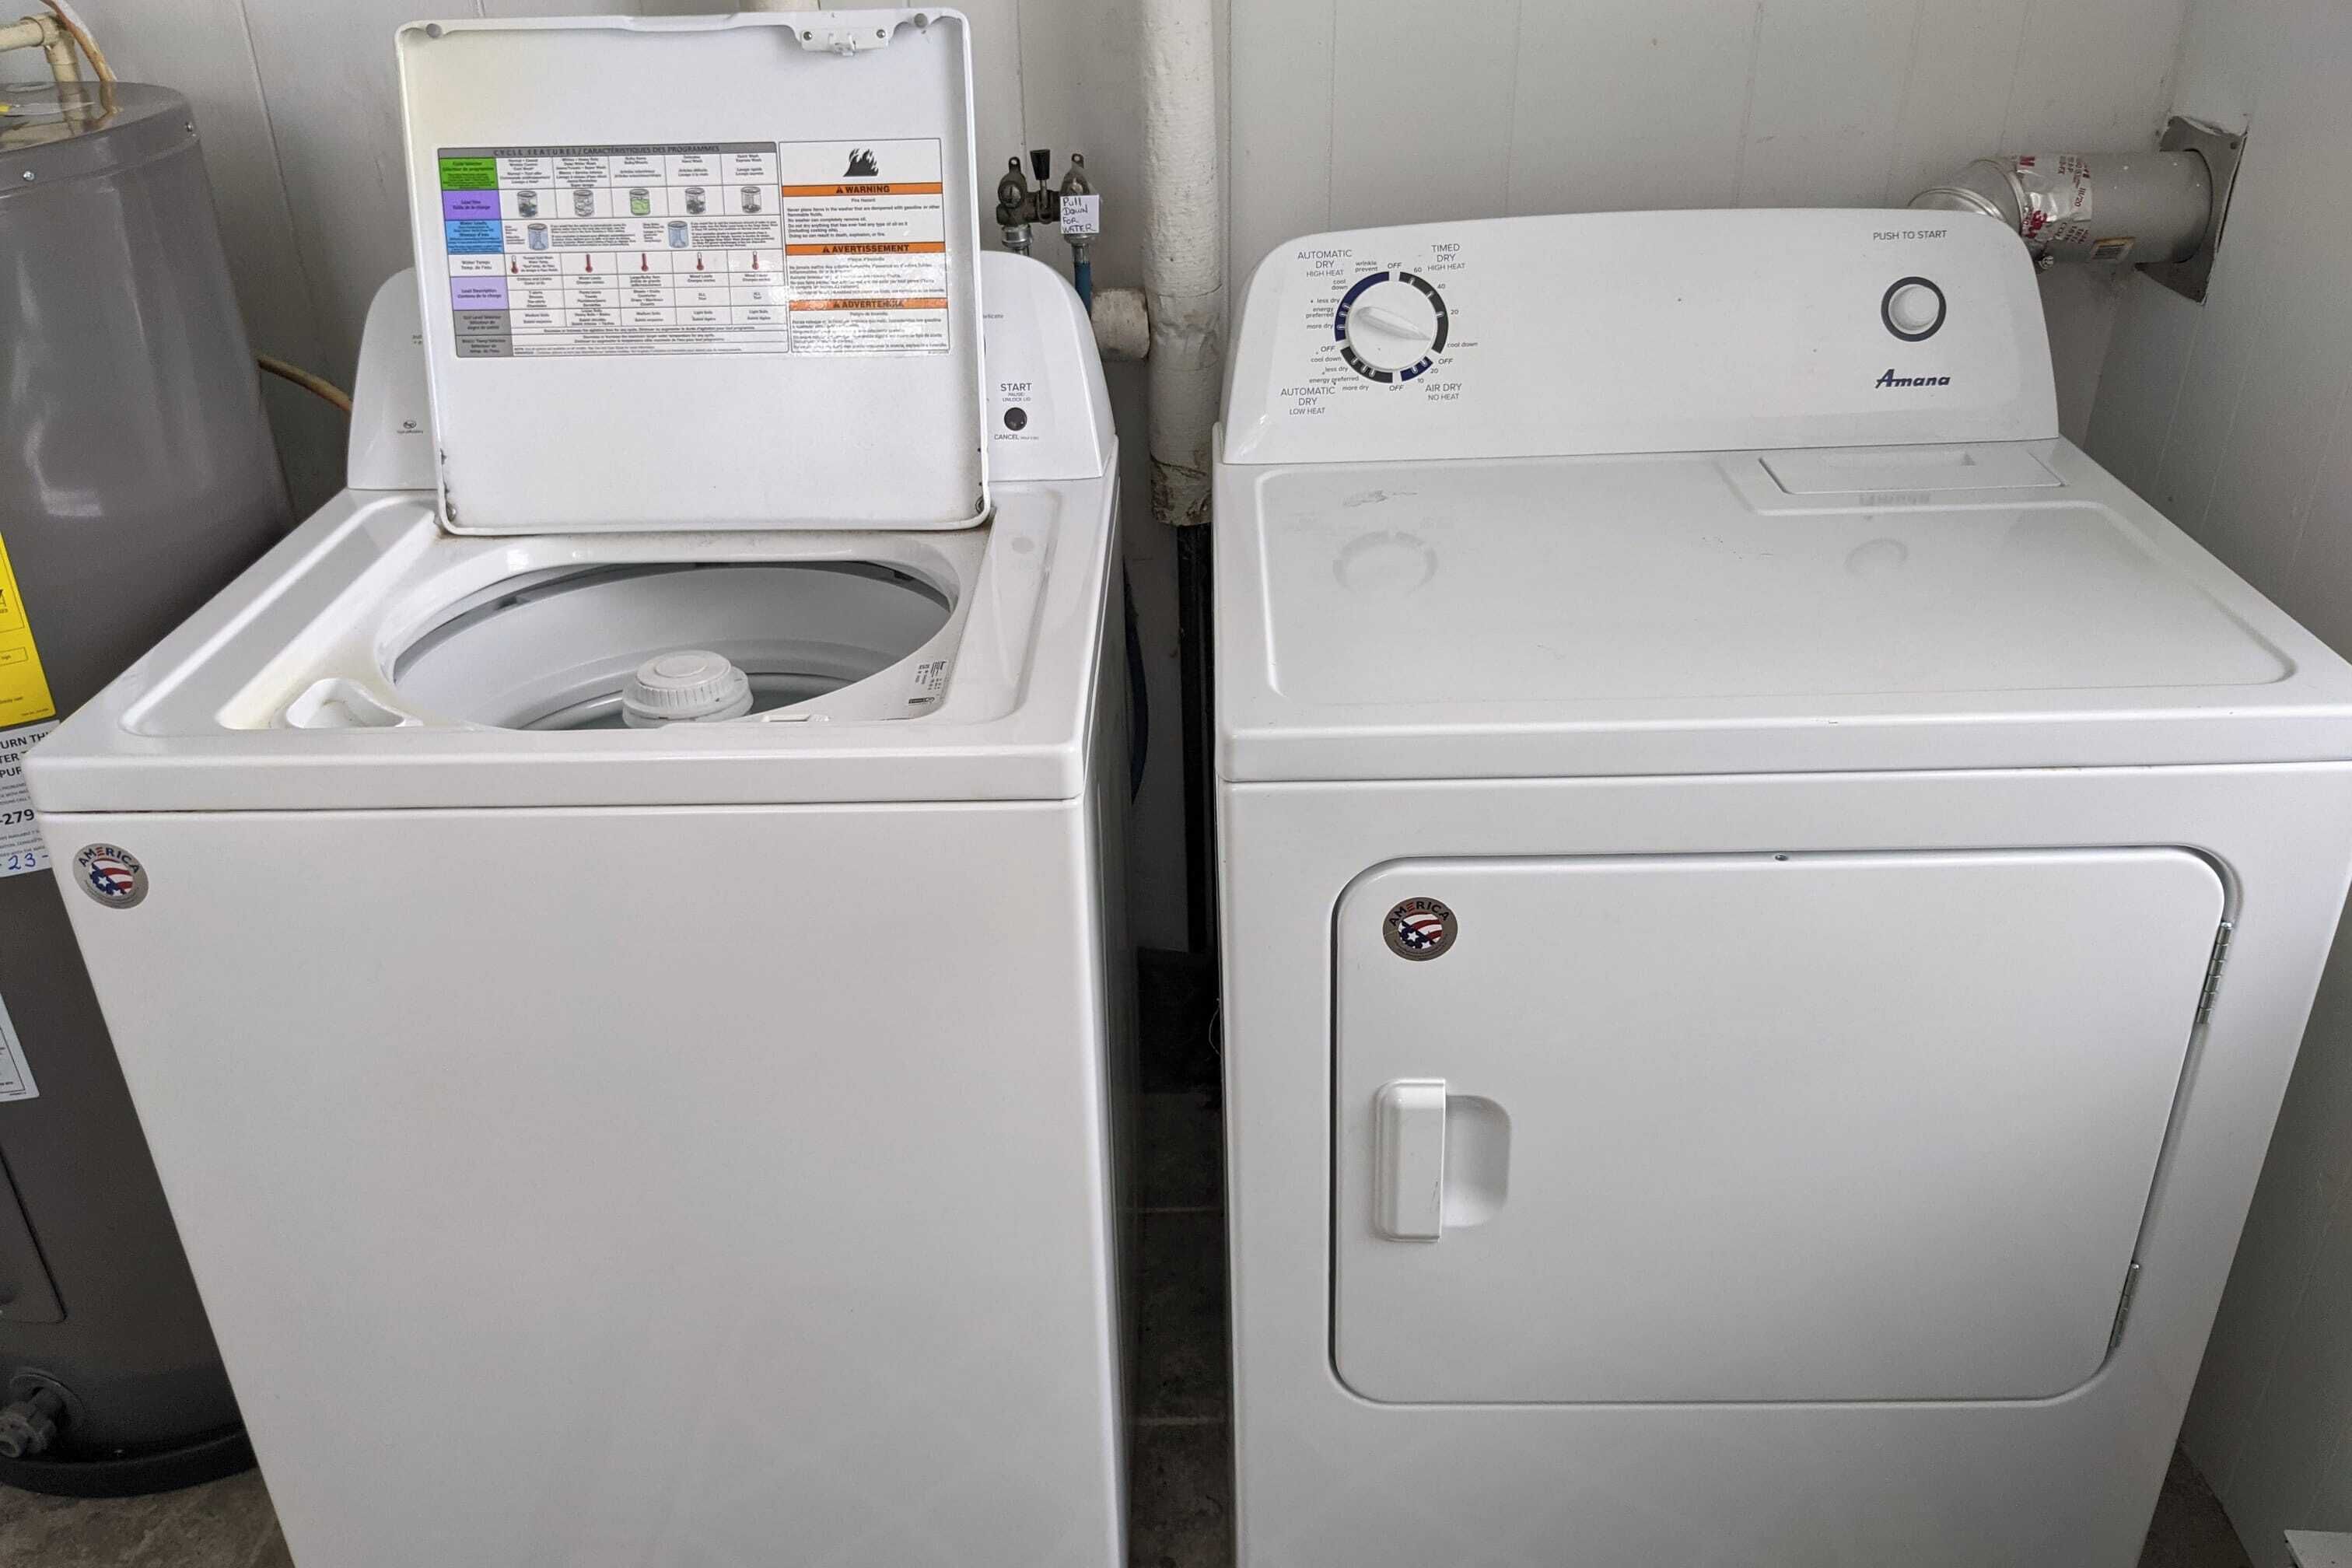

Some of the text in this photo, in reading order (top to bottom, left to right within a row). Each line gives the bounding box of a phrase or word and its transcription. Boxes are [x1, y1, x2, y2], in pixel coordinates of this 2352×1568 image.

[845, 185, 891, 194] WARNING
[1873, 230, 1947, 240] PUSH TO START
[832, 243, 909, 254] AVERTISSEMENT
[1431, 243, 1460, 252] TIMED
[1297, 250, 1353, 259] AUTOMATIC
[1315, 261, 1335, 269] DRY
[1332, 375, 1359, 383] preferred
[1875, 369, 1951, 389] Amana
[1000, 383, 1032, 392] START
[1280, 387, 1335, 396] AUTOMATIC
[1443, 383, 1462, 392] DRY
[1298, 397, 1318, 406] DRY
[30, 731, 49, 743] TH
[8, 852, 36, 870] 23
[79, 846, 140, 873] AMERICA
[1388, 901, 1450, 926] AMERICA
